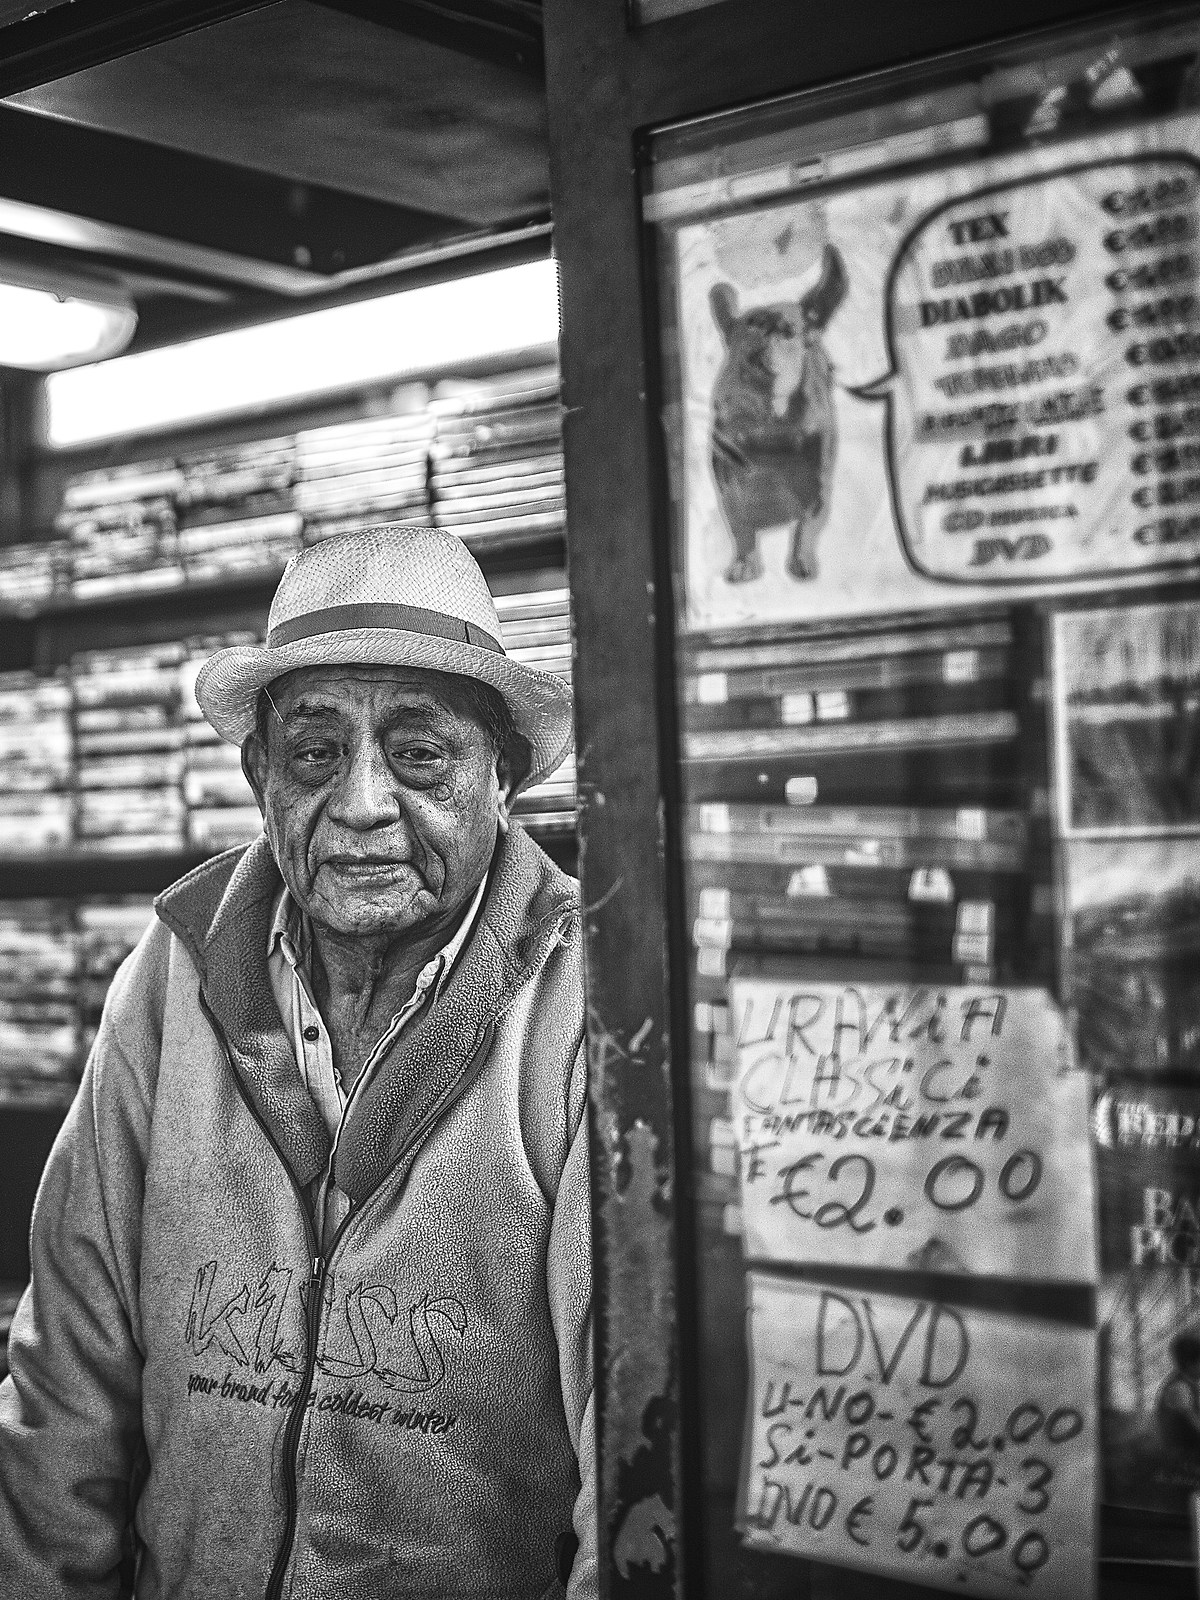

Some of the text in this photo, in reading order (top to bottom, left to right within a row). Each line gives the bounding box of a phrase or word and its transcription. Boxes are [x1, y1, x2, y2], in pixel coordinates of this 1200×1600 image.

[947, 210, 1009, 246] TEX
[919, 277, 1068, 328] DIABOLIK
[815, 1290, 970, 1389] DVD
[187, 1373, 218, 1396] your
[220, 1373, 274, 1406] brand
